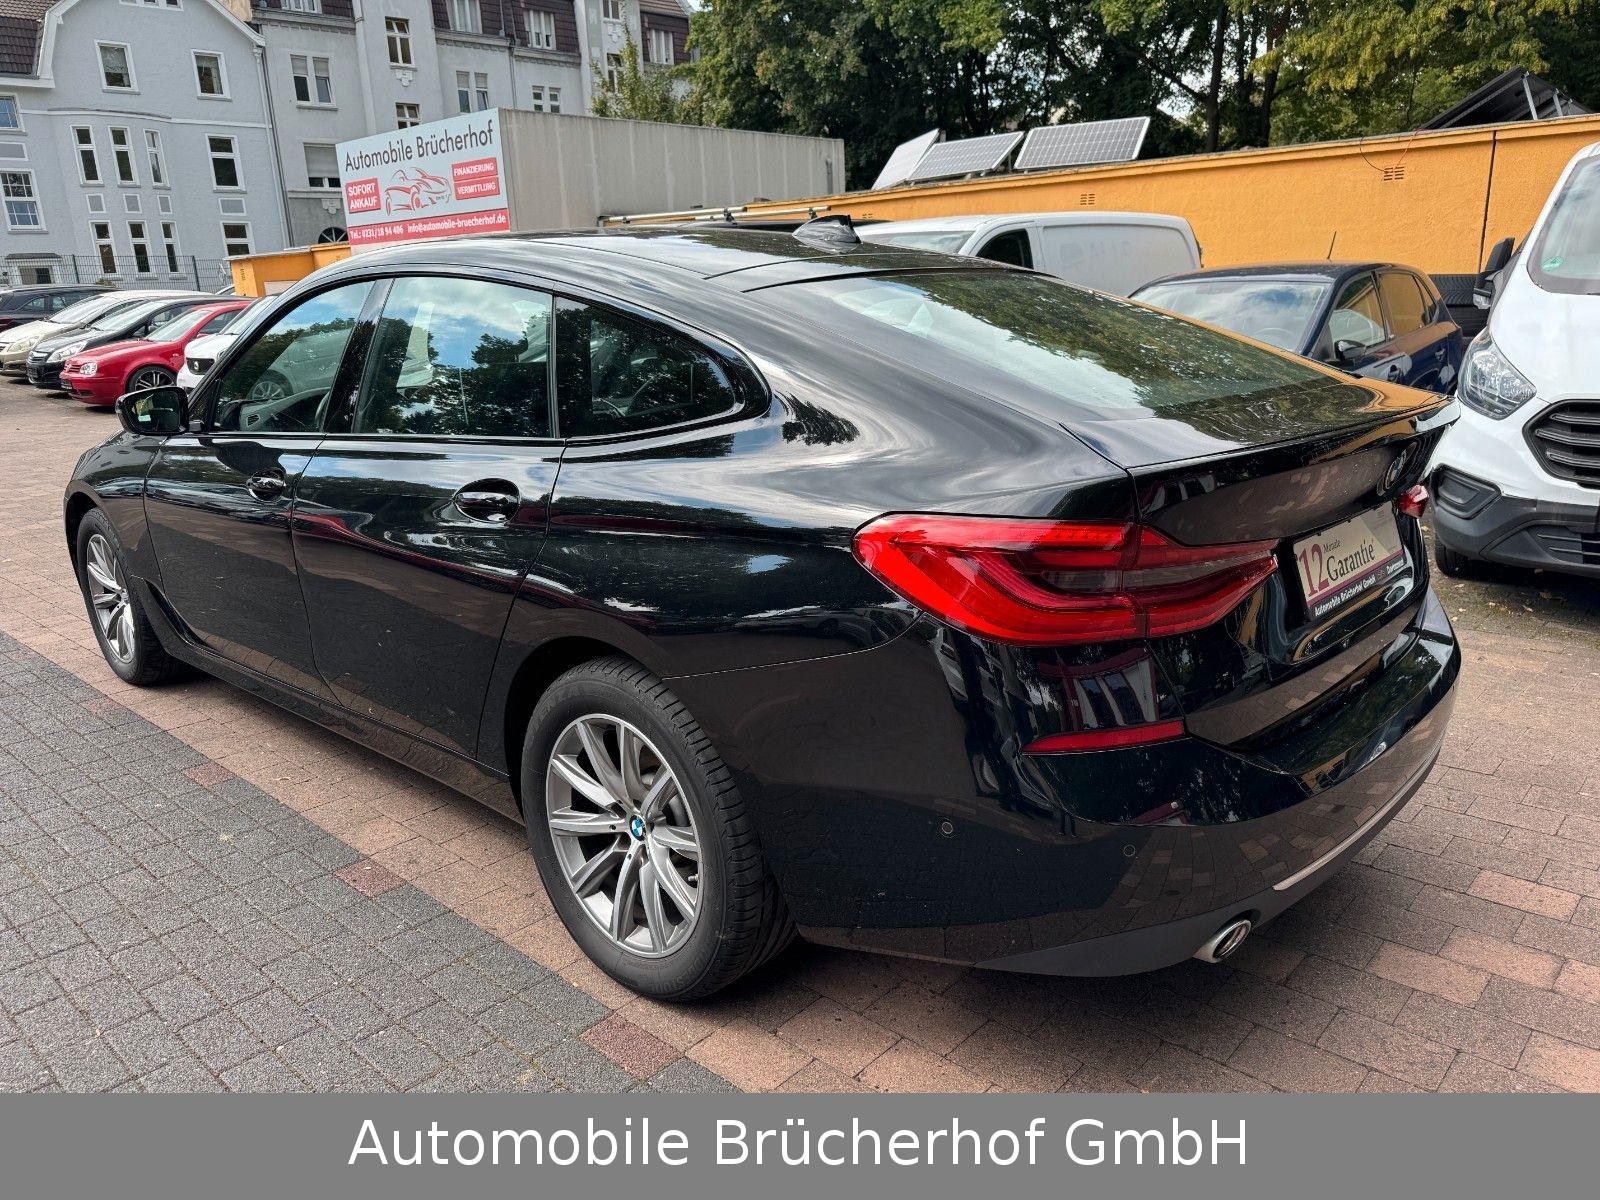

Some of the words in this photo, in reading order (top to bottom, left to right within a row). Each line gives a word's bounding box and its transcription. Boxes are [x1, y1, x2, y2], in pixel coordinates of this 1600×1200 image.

[345, 139, 413, 172] Automobile
[416, 119, 494, 159] Brücherhof
[453, 162, 495, 176] FINANZIERUNG
[348, 183, 376, 197] SOFORT
[457, 181, 496, 195] VERMITTLUNG
[350, 195, 378, 210] ANKAUF
[1299, 543, 1330, 597] 12
